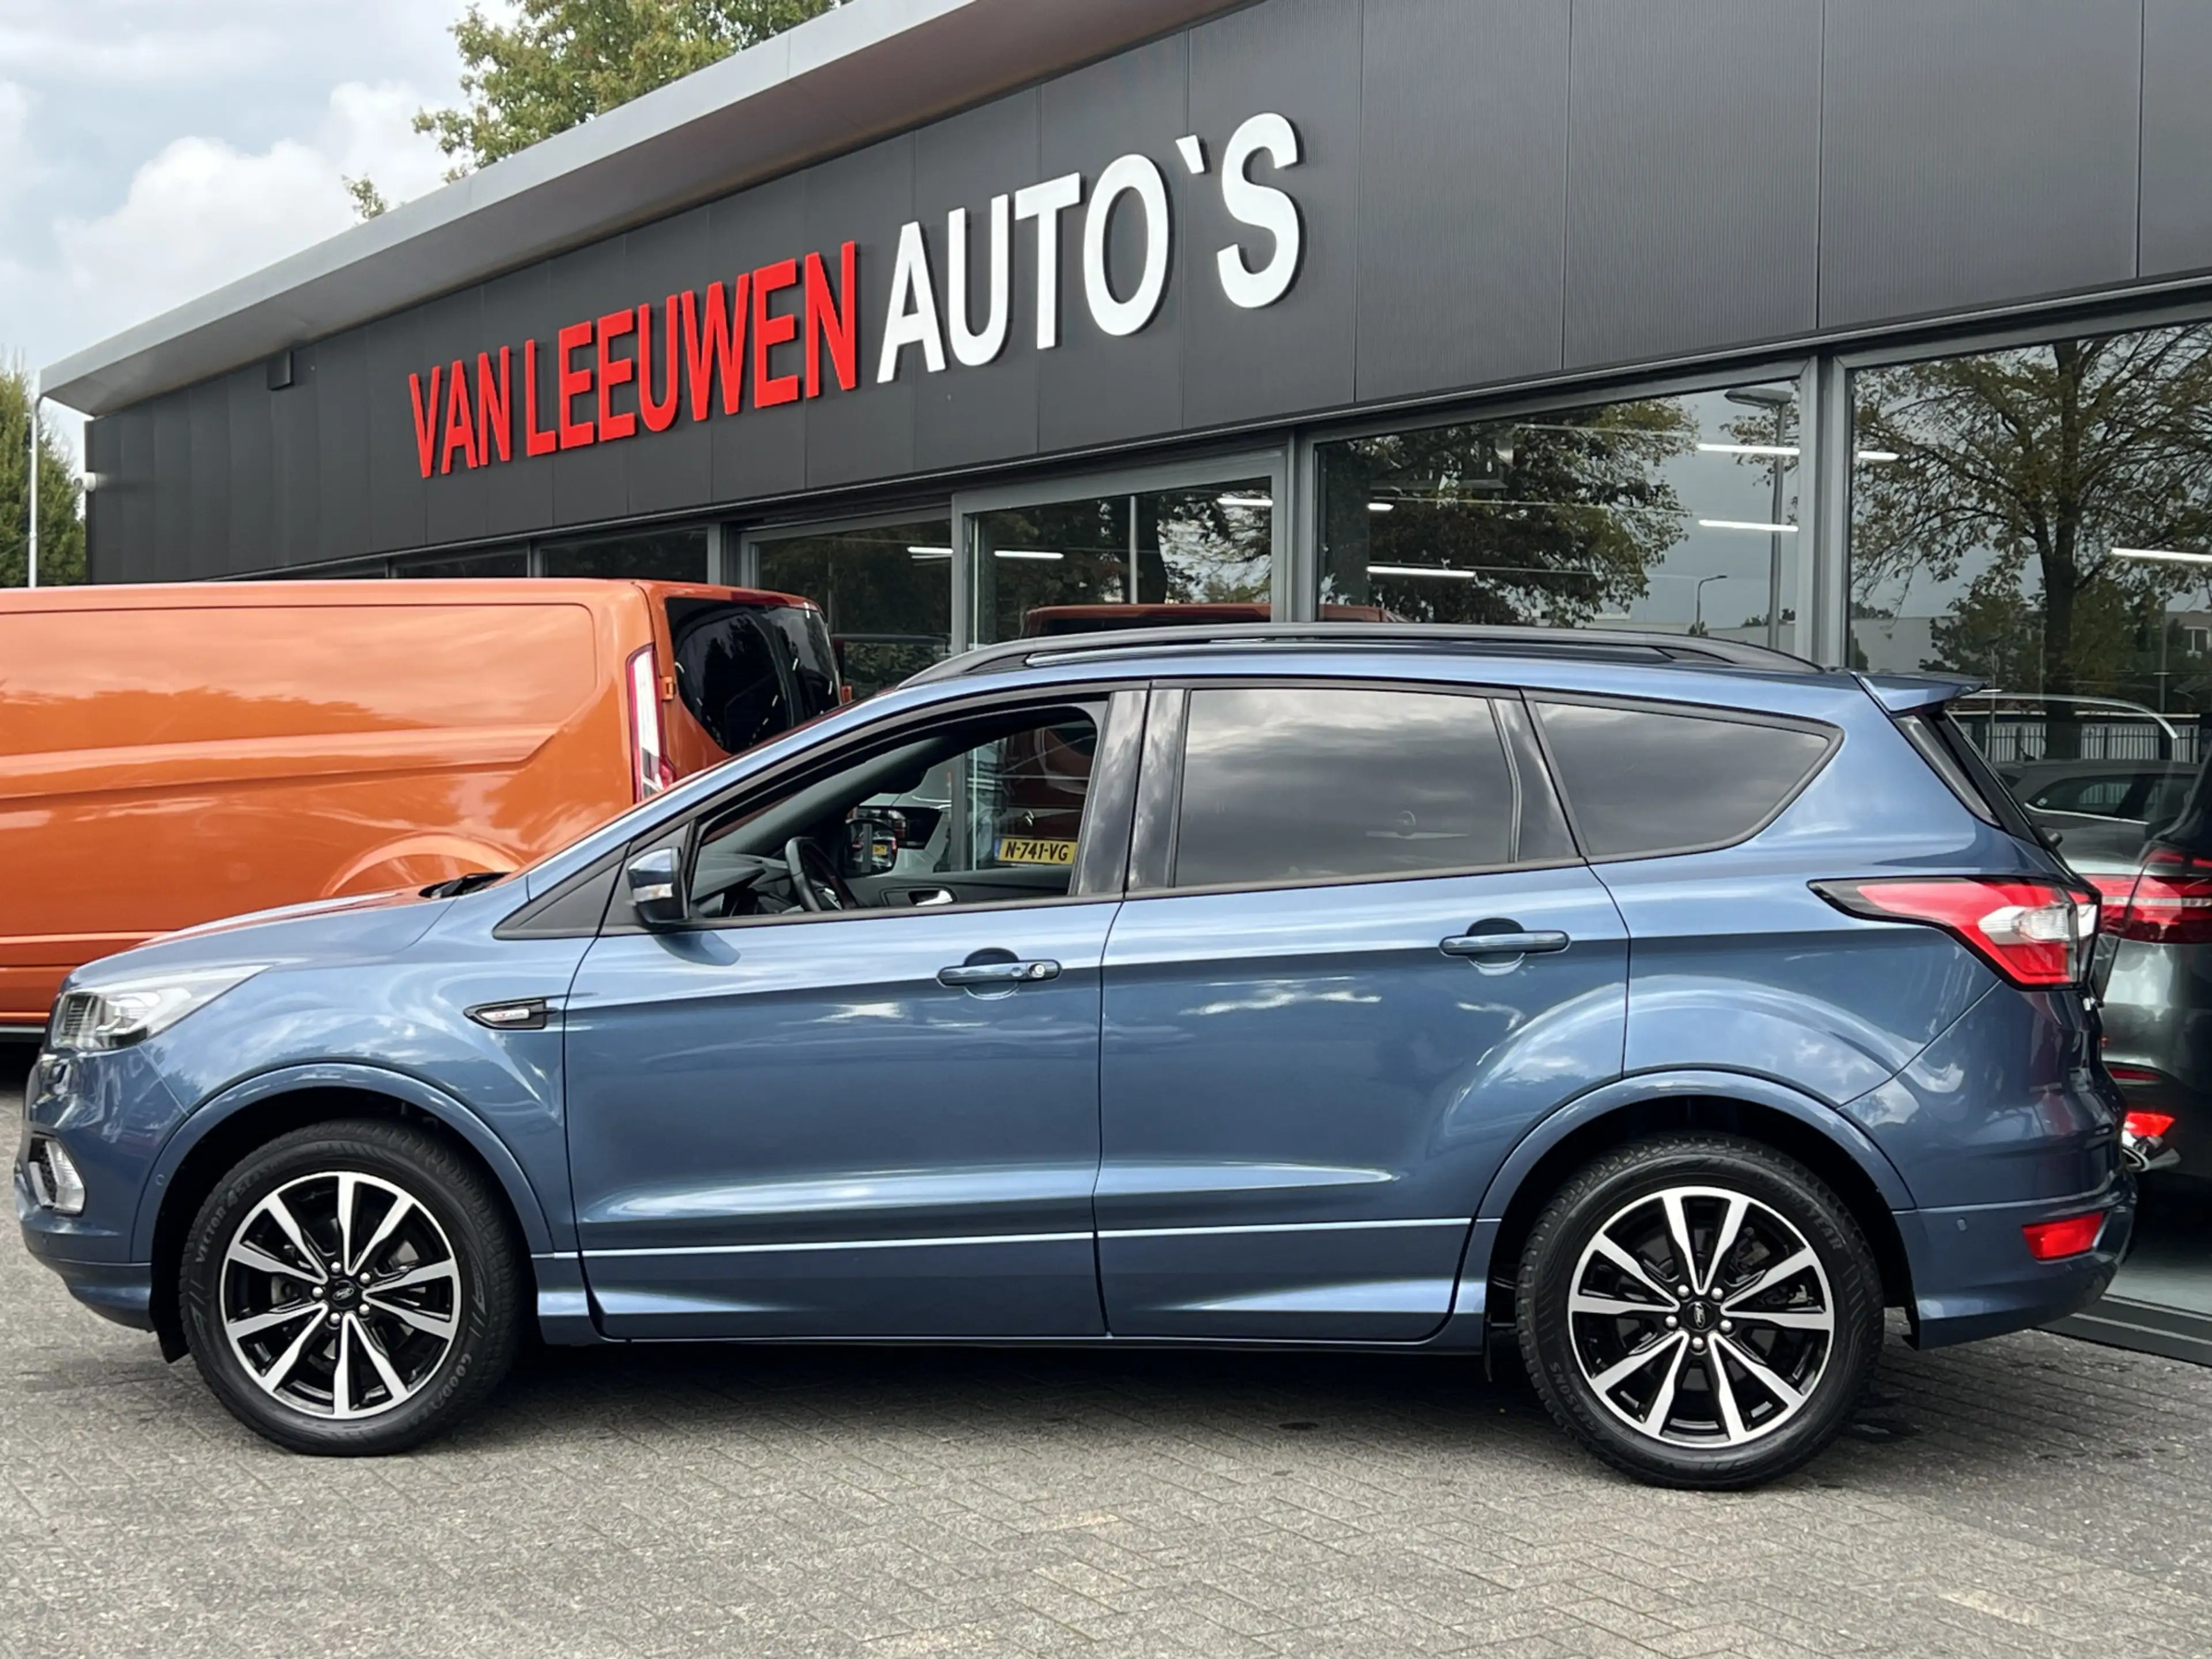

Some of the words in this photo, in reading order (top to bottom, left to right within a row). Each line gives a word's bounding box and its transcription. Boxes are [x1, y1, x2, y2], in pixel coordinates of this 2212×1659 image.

[408, 346, 510, 478] VAN
[525, 241, 856, 457] LEEUWEN
[1004, 841, 1070, 861] N-741-VG
